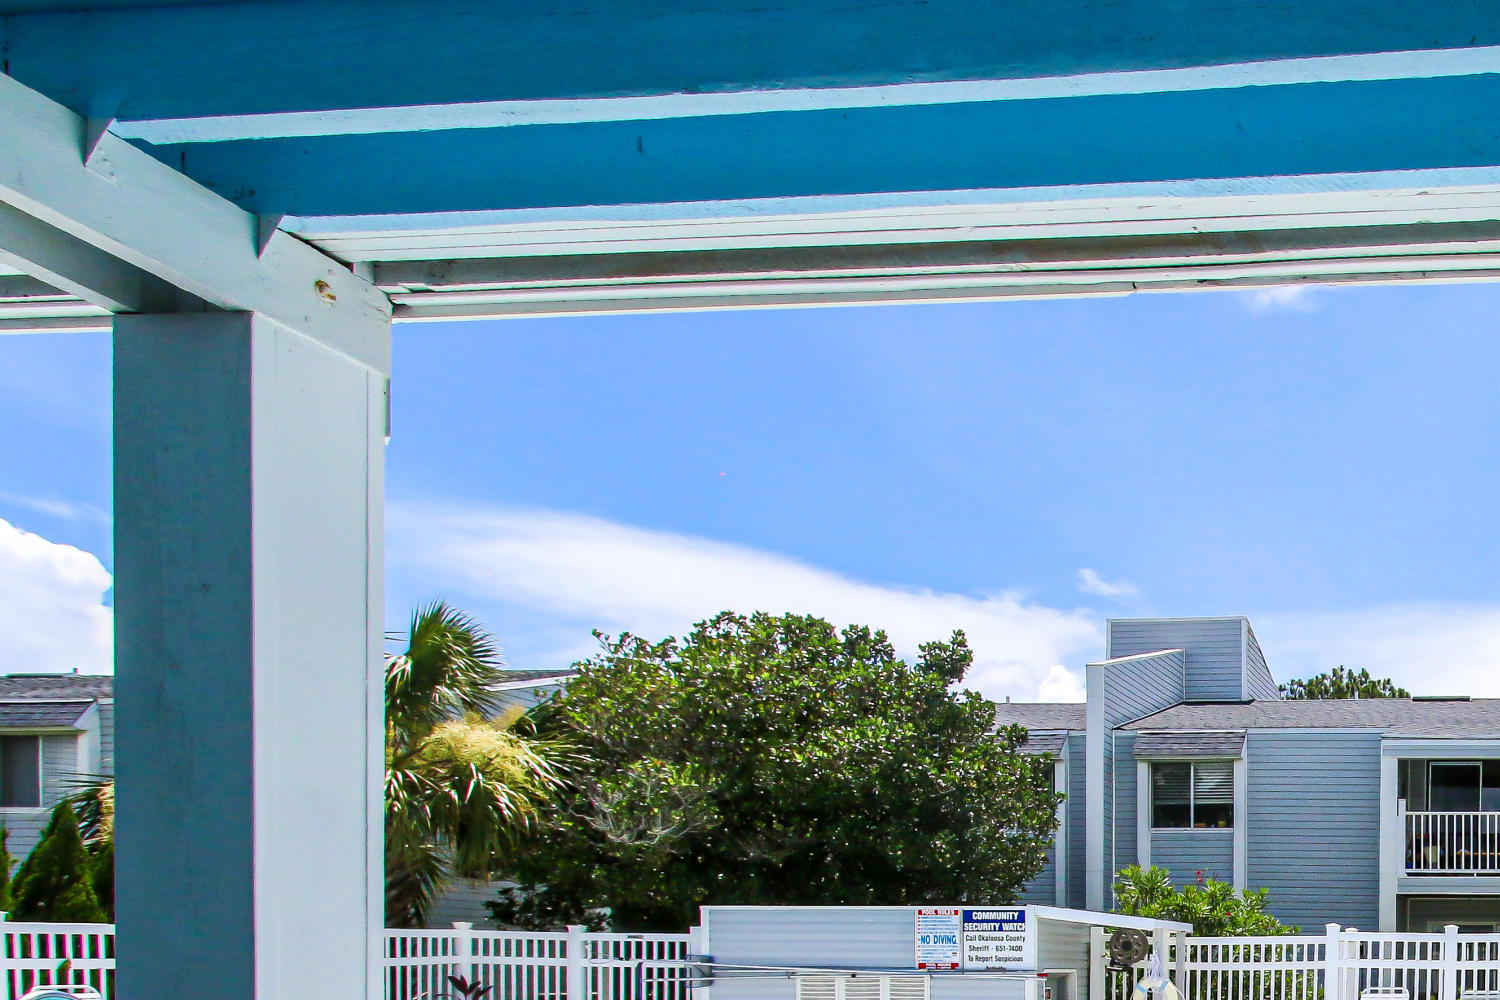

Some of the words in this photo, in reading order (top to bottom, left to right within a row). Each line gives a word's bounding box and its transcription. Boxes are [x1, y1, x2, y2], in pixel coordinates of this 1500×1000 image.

[972, 912, 1019, 920] COMMUNITY
[964, 922, 1001, 931] SECURITY
[1002, 922, 1026, 931] WATCH
[920, 935, 931, 945] NO
[965, 934, 977, 942] Call
[978, 934, 1004, 942] Okaloosa
[1005, 934, 1026, 943] County
[975, 955, 993, 963] Report
[994, 955, 1024, 963] Suspicious
